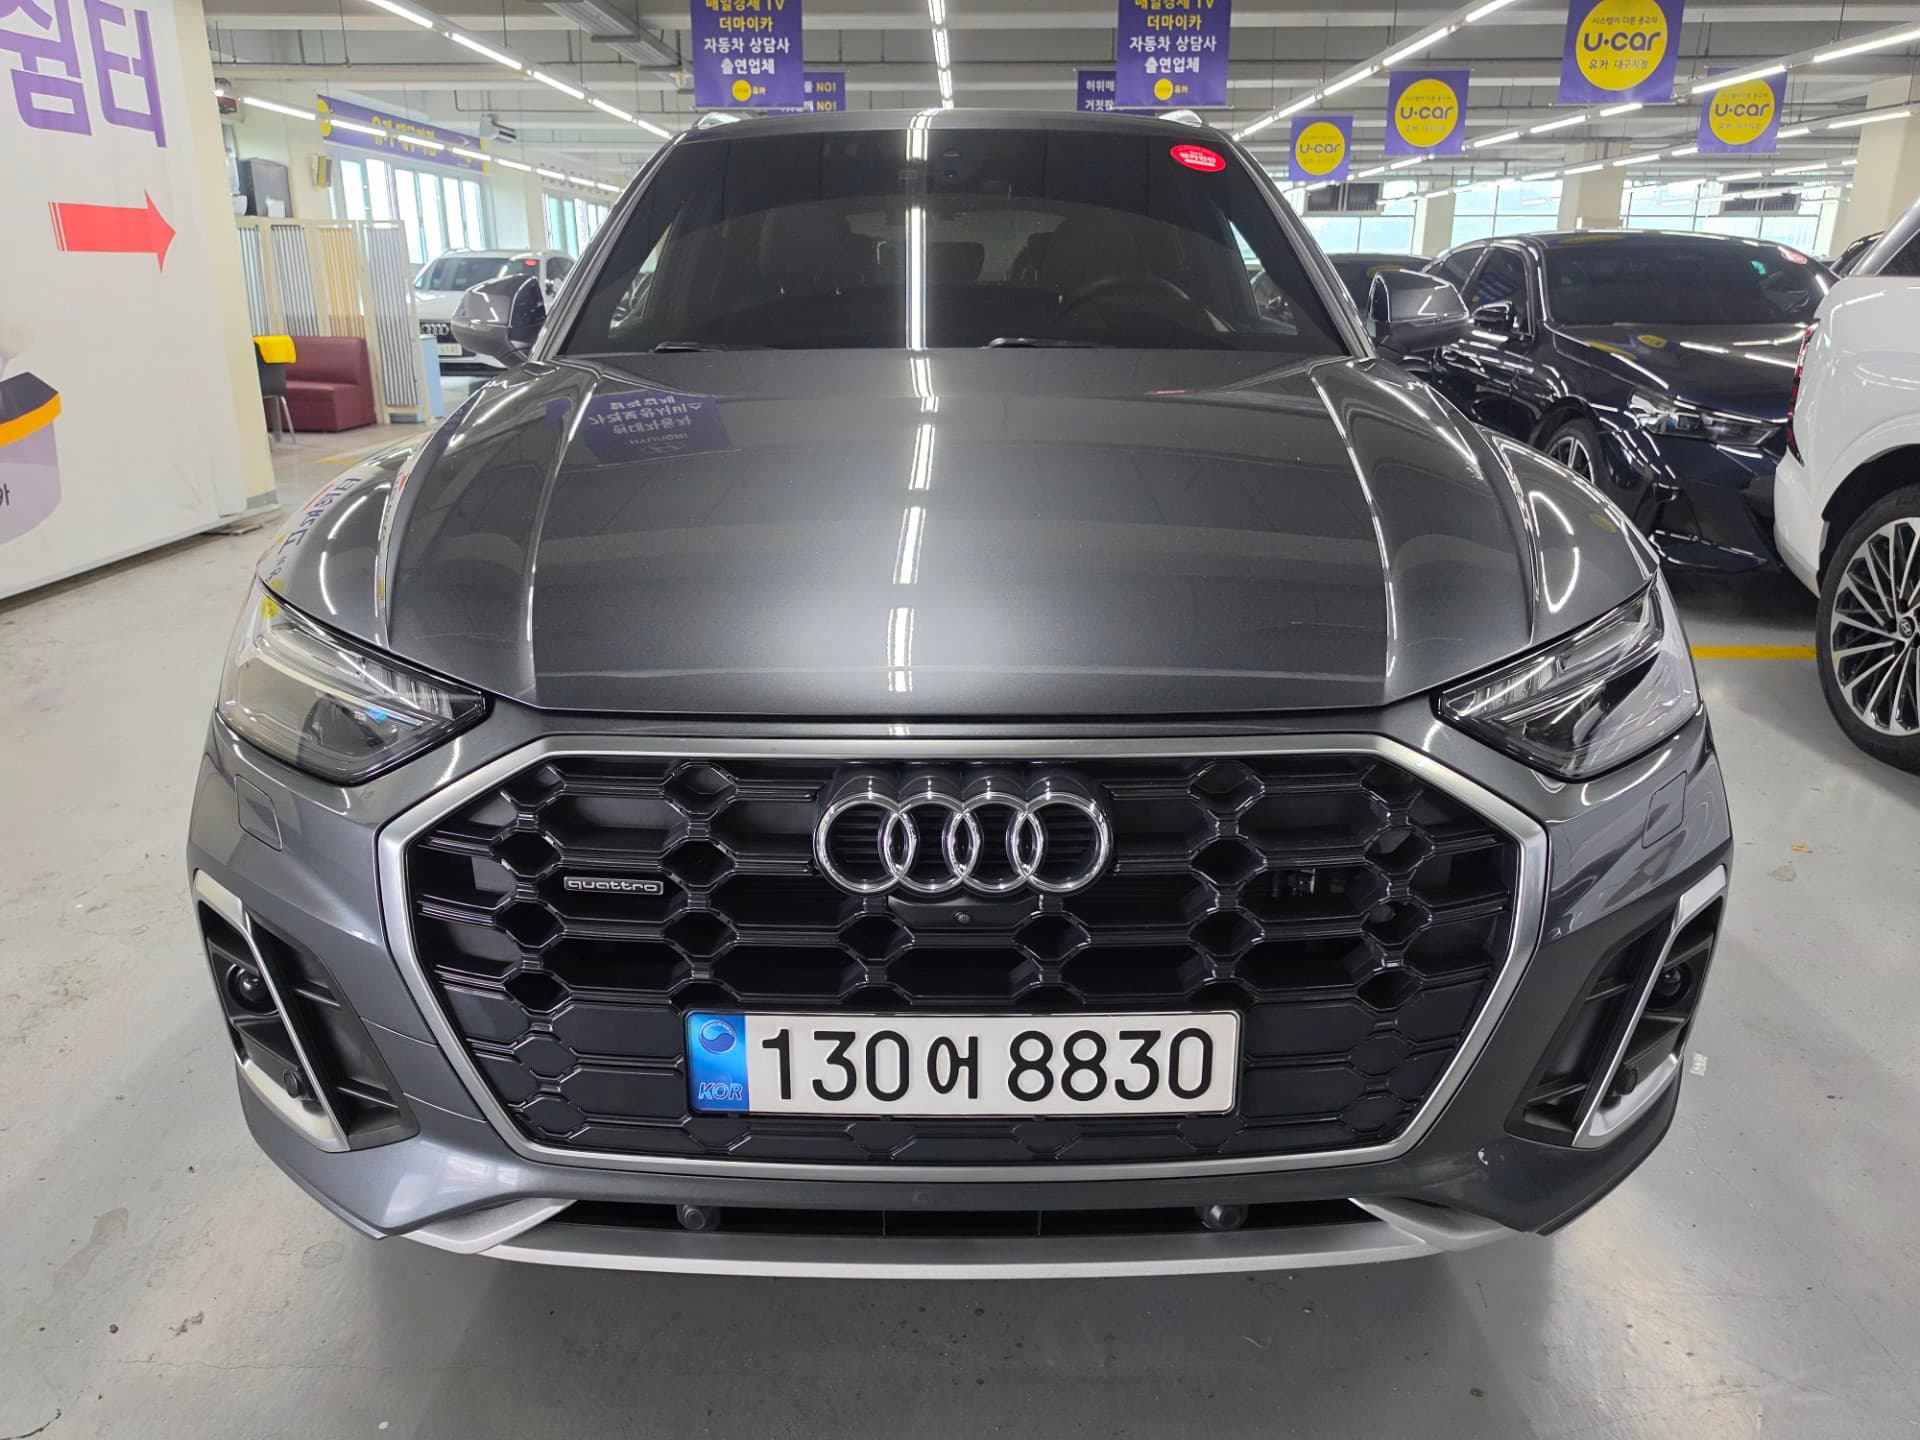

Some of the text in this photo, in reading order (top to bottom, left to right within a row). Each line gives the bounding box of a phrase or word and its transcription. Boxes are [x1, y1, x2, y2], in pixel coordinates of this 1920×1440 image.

[719, 16, 774, 32] 더마이카
[1147, 14, 1203, 31] 더마이카
[703, 37, 790, 54] 자동차 상담사
[1129, 36, 1217, 52] 자동차 상담사
[720, 58, 775, 75] 출연업체
[1144, 56, 1201, 73] 출연업체
[816, 82, 837, 93] NO!
[1086, 80, 1115, 92] 허위매
[816, 101, 837, 111] NO!
[567, 880, 658, 892] quattro
[762, 1027, 1215, 1102] 130어 8830
[698, 1081, 743, 1100] KOR
